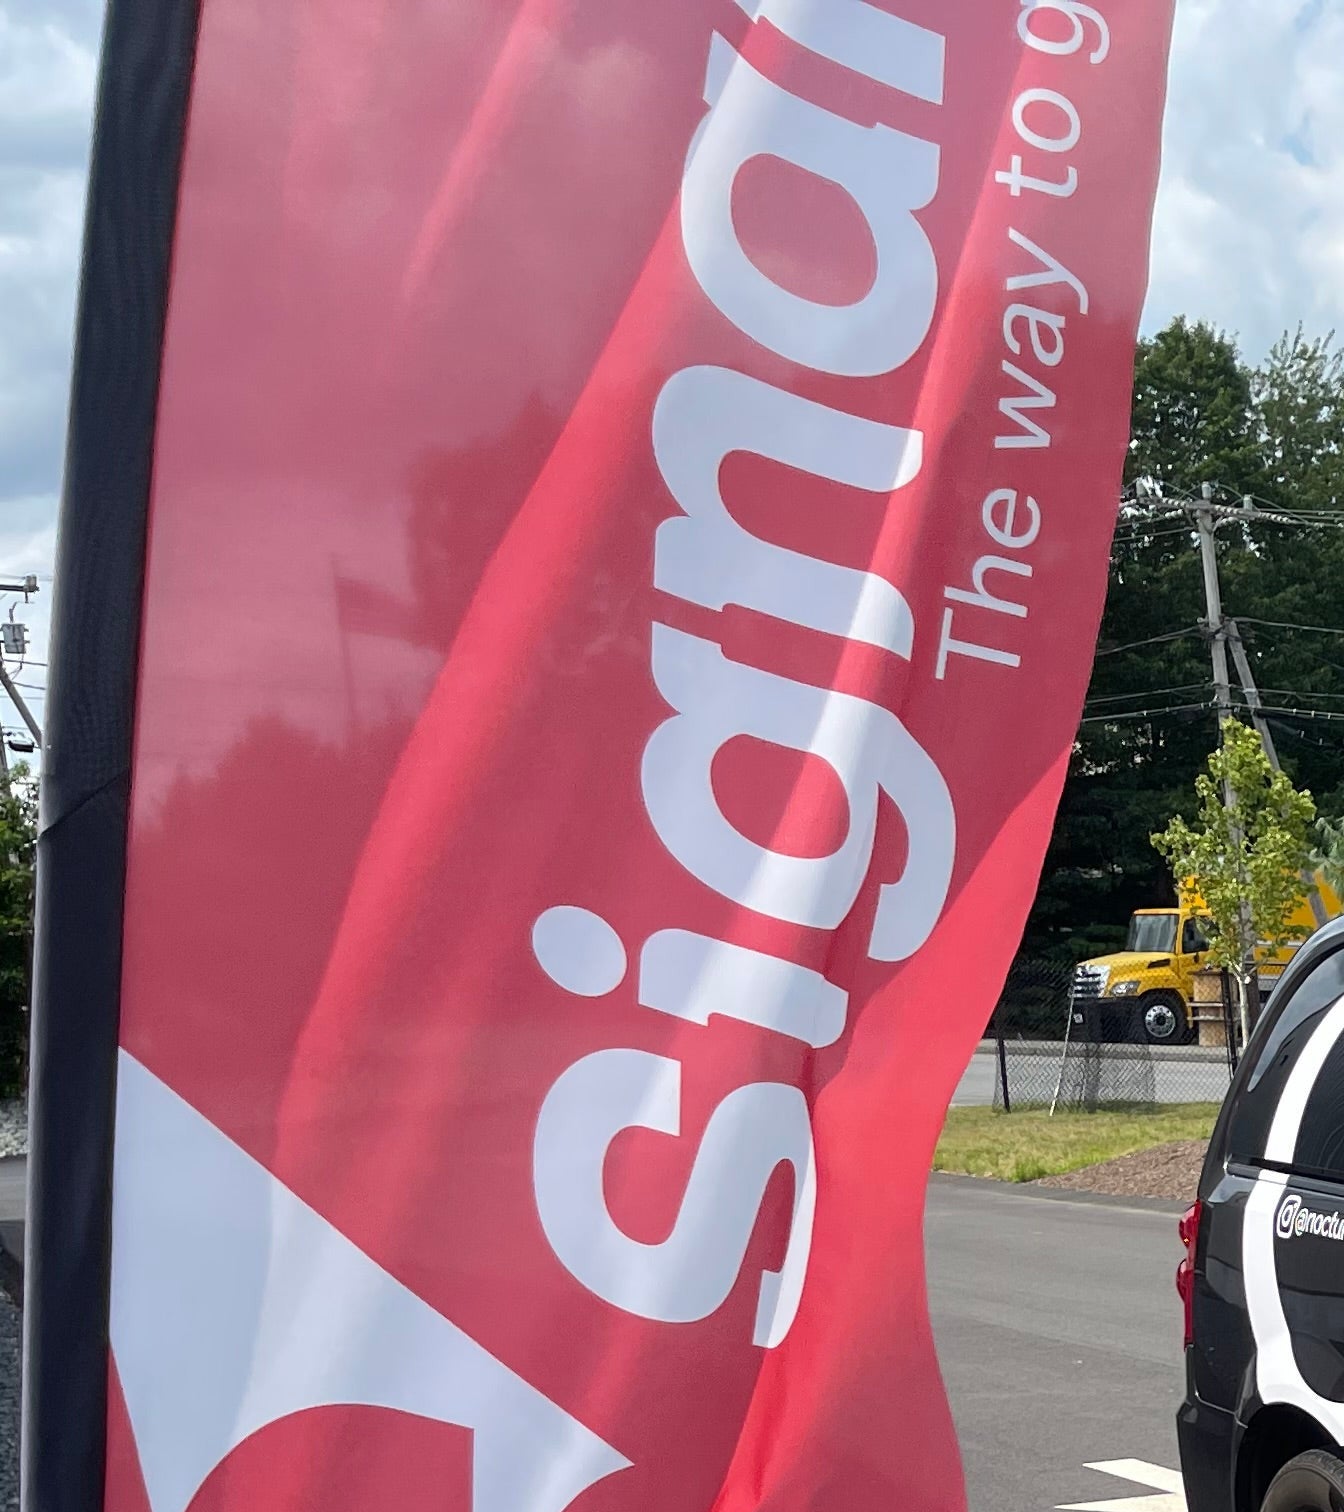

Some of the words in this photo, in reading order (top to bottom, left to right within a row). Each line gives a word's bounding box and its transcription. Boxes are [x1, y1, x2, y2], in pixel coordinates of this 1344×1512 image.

[994, 87, 1082, 197] to
[994, 227, 1089, 450] way
[936, 487, 1042, 681] The
